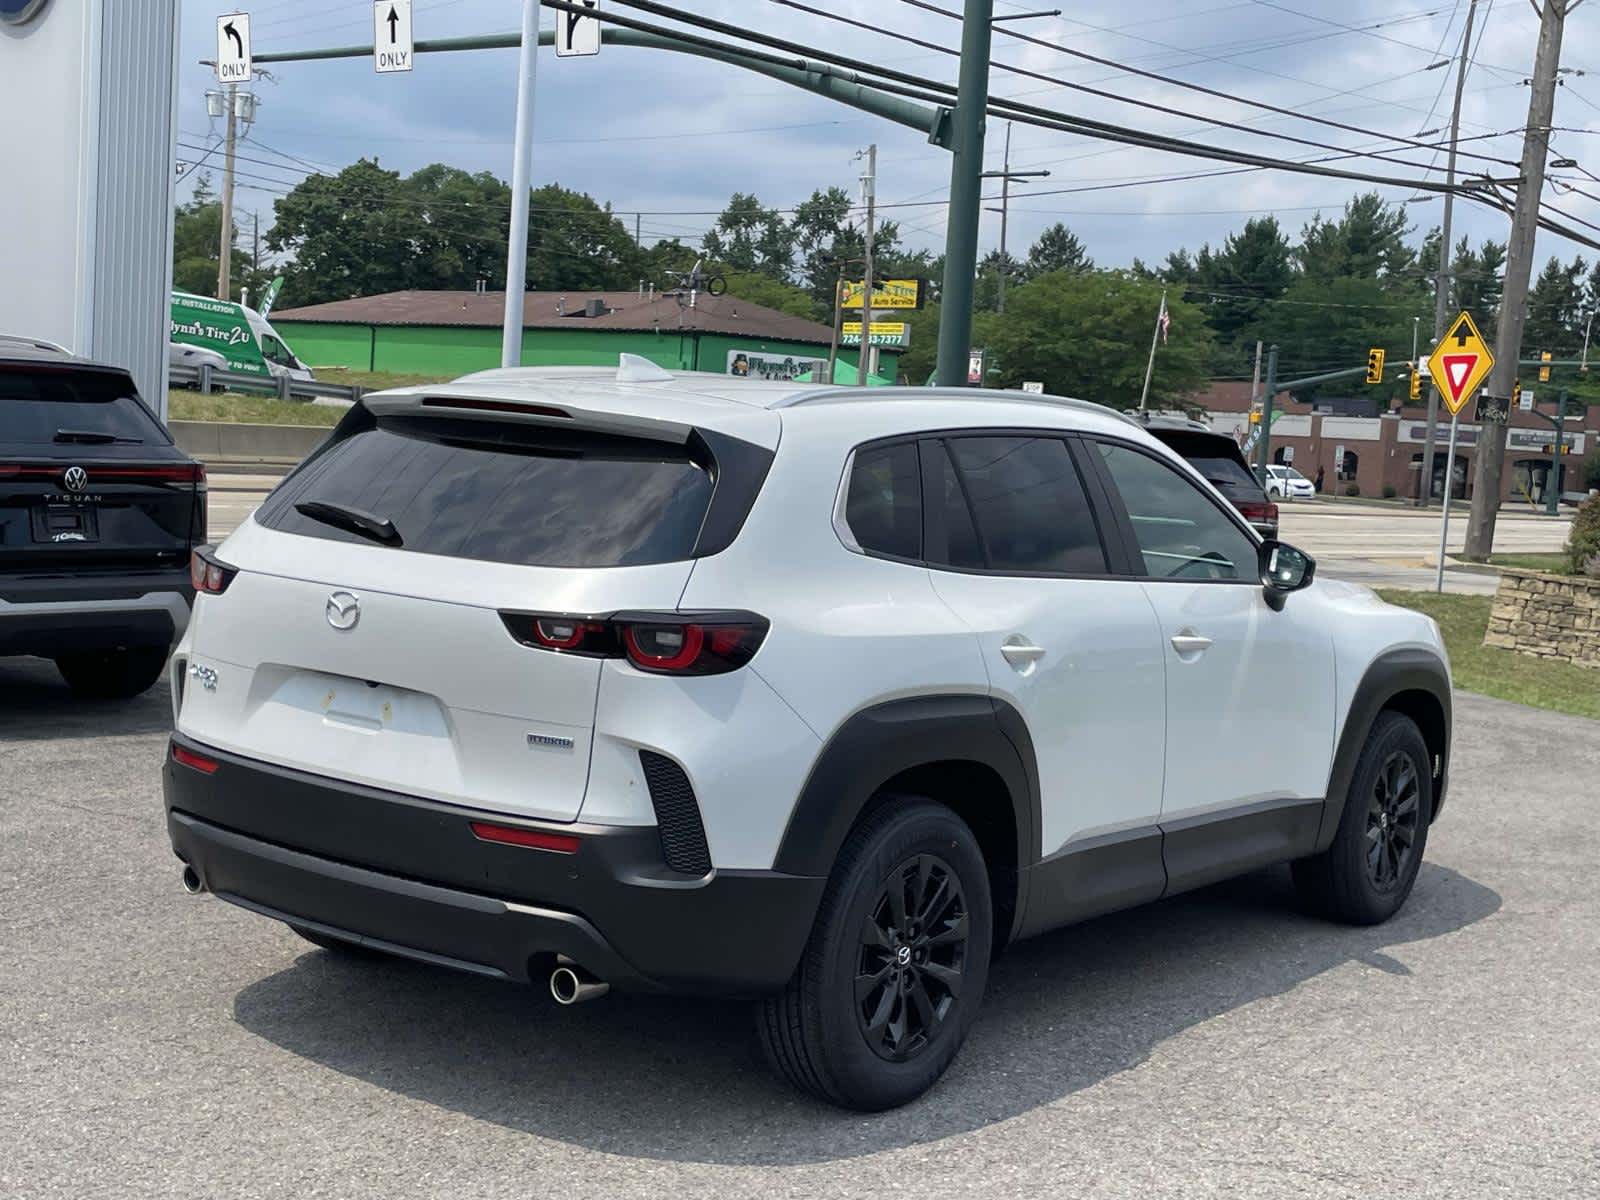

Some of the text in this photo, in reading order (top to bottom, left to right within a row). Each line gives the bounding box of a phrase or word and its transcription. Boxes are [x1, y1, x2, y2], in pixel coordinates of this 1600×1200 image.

[380, 52, 407, 67] ONLY
[222, 63, 246, 77] ONLY
[171, 320, 204, 335] lynn's
[843, 335, 903, 344] 724-33-7377
[43, 494, 102, 502] TIGUAN
